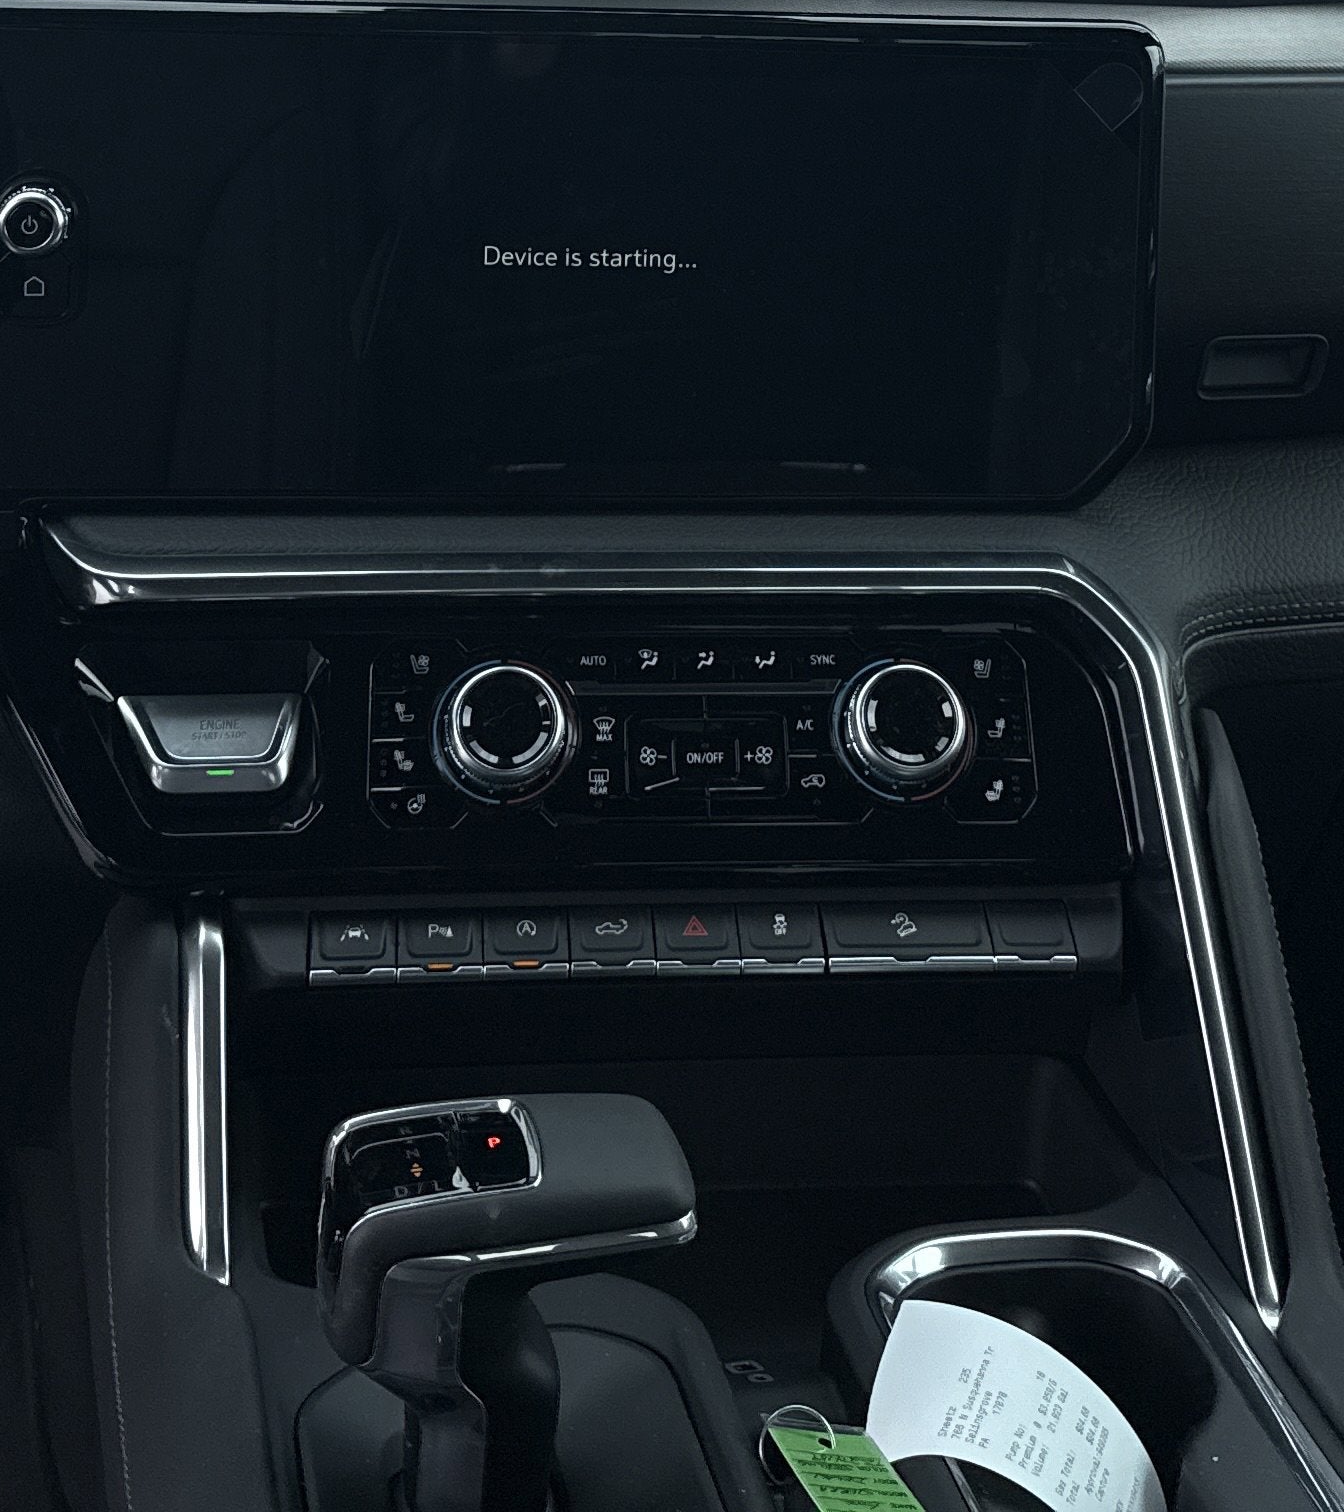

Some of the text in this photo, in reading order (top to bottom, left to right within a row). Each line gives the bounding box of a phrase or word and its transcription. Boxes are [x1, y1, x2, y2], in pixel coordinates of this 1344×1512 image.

[483, 245, 698, 274] Device is starting...
[580, 655, 606, 666] AUTO
[810, 654, 836, 666] SYNC
[200, 718, 241, 731] ENGINE
[796, 719, 814, 732] A/C
[596, 734, 613, 742] MAX
[686, 752, 724, 765] ON/OFF
[487, 1136, 501, 1149] P
[963, 1359, 990, 1410] Susquehanna
[984, 1346, 994, 1356] Tr
[938, 1368, 972, 1438] Sheetz 235
[965, 1390, 992, 1444] Selinsgrove
[978, 1438, 990, 1448] PA
[1005, 1442, 1021, 1462] Pump
[1018, 1436, 1036, 1469] Premium
[1066, 1480, 1080, 1506] Total
